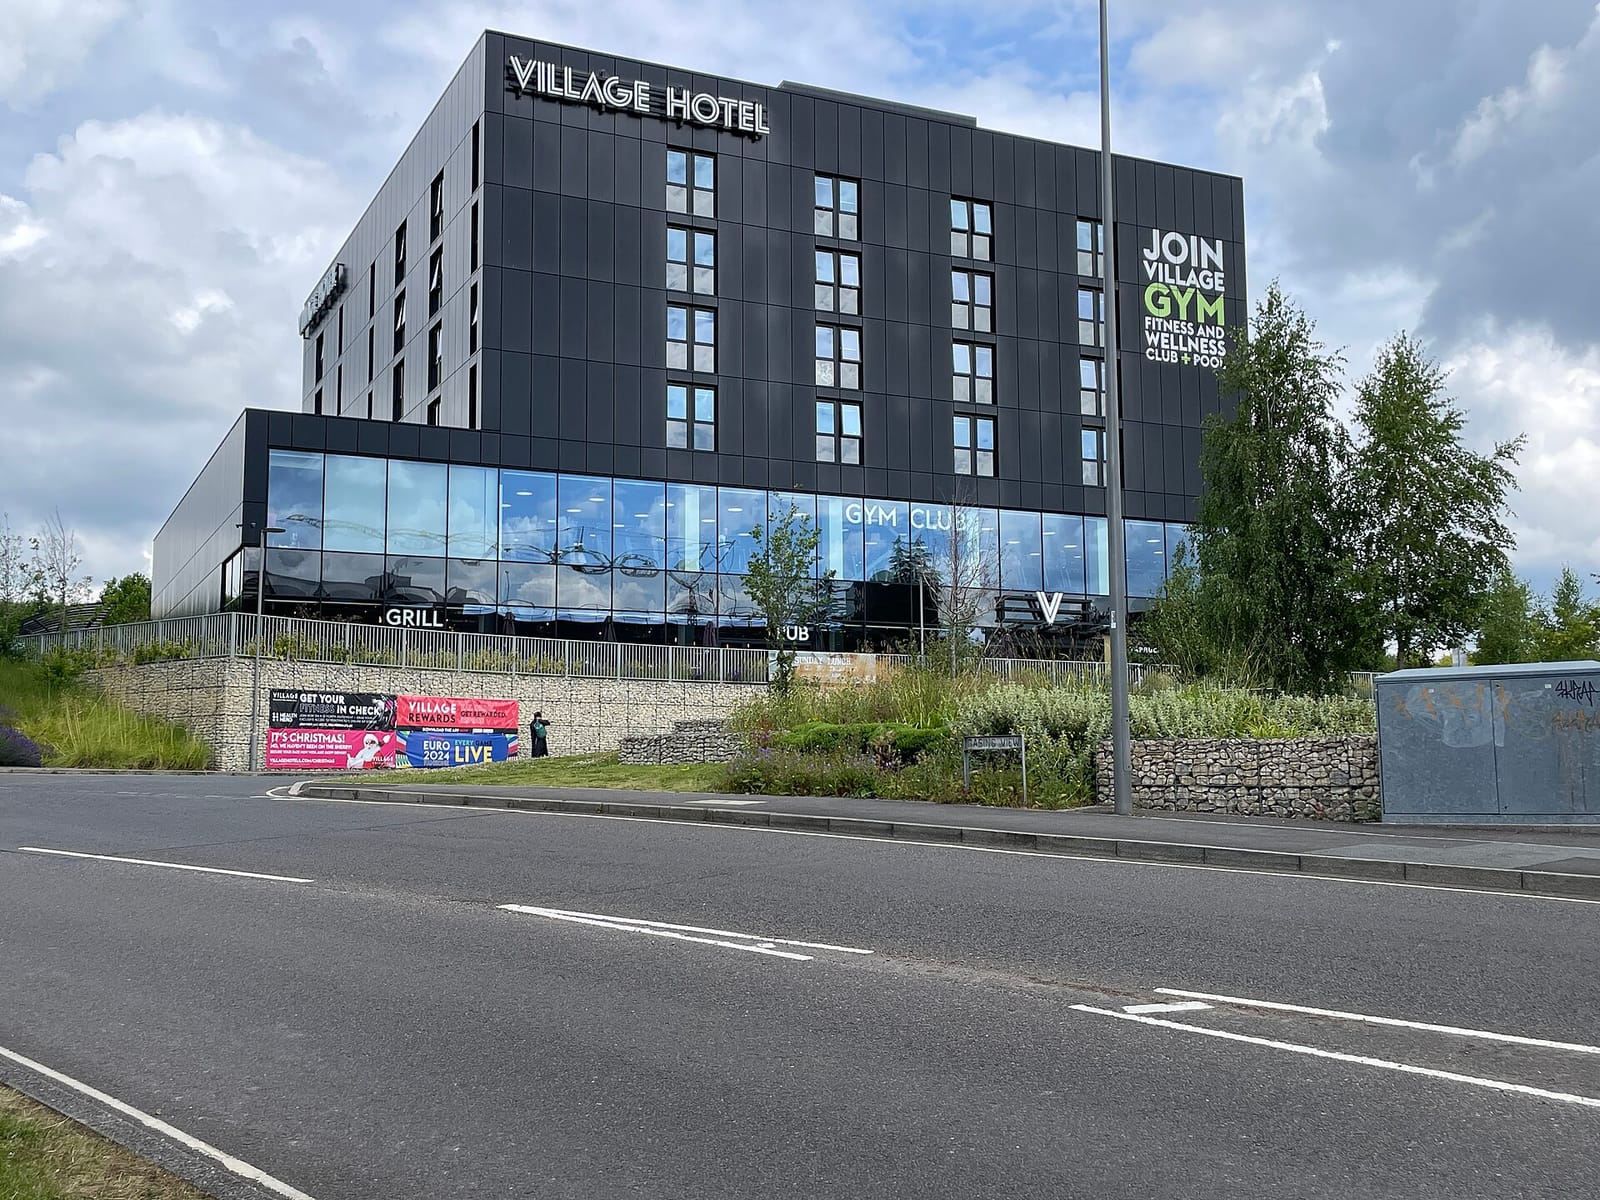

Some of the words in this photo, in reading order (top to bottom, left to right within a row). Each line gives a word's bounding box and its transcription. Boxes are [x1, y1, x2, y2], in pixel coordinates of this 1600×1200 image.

[510, 55, 650, 112] VILLAGE
[666, 86, 770, 134] HOTEL
[1143, 229, 1223, 271] JOIN
[1143, 260, 1225, 292] VILLAGE
[1144, 282, 1225, 326] GYM
[1145, 316, 1194, 335] FITNESS
[1197, 325, 1225, 339] AND
[1145, 330, 1226, 357] WELLNESS
[1146, 348, 1178, 363] CLUB
[845, 503, 897, 527] GYM
[911, 508, 966, 531] CLUB
[386, 609, 443, 627] GRILL
[794, 656, 822, 665] SUNDAY
[827, 657, 851, 665] LUNCH
[300, 693, 318, 703] GET
[319, 694, 345, 704] YOUR
[300, 703, 335, 713] FITNESS
[336, 705, 347, 714] IN
[349, 705, 380, 716] CHECK
[409, 702, 457, 714] VILLAGE
[408, 713, 456, 723] REWARDS
[271, 732, 288, 743] IT'S
[289, 733, 345, 744] CHRISTMAS!
[423, 740, 450, 750] EURO
[423, 751, 450, 760] 2024
[455, 746, 493, 763] LIVE
